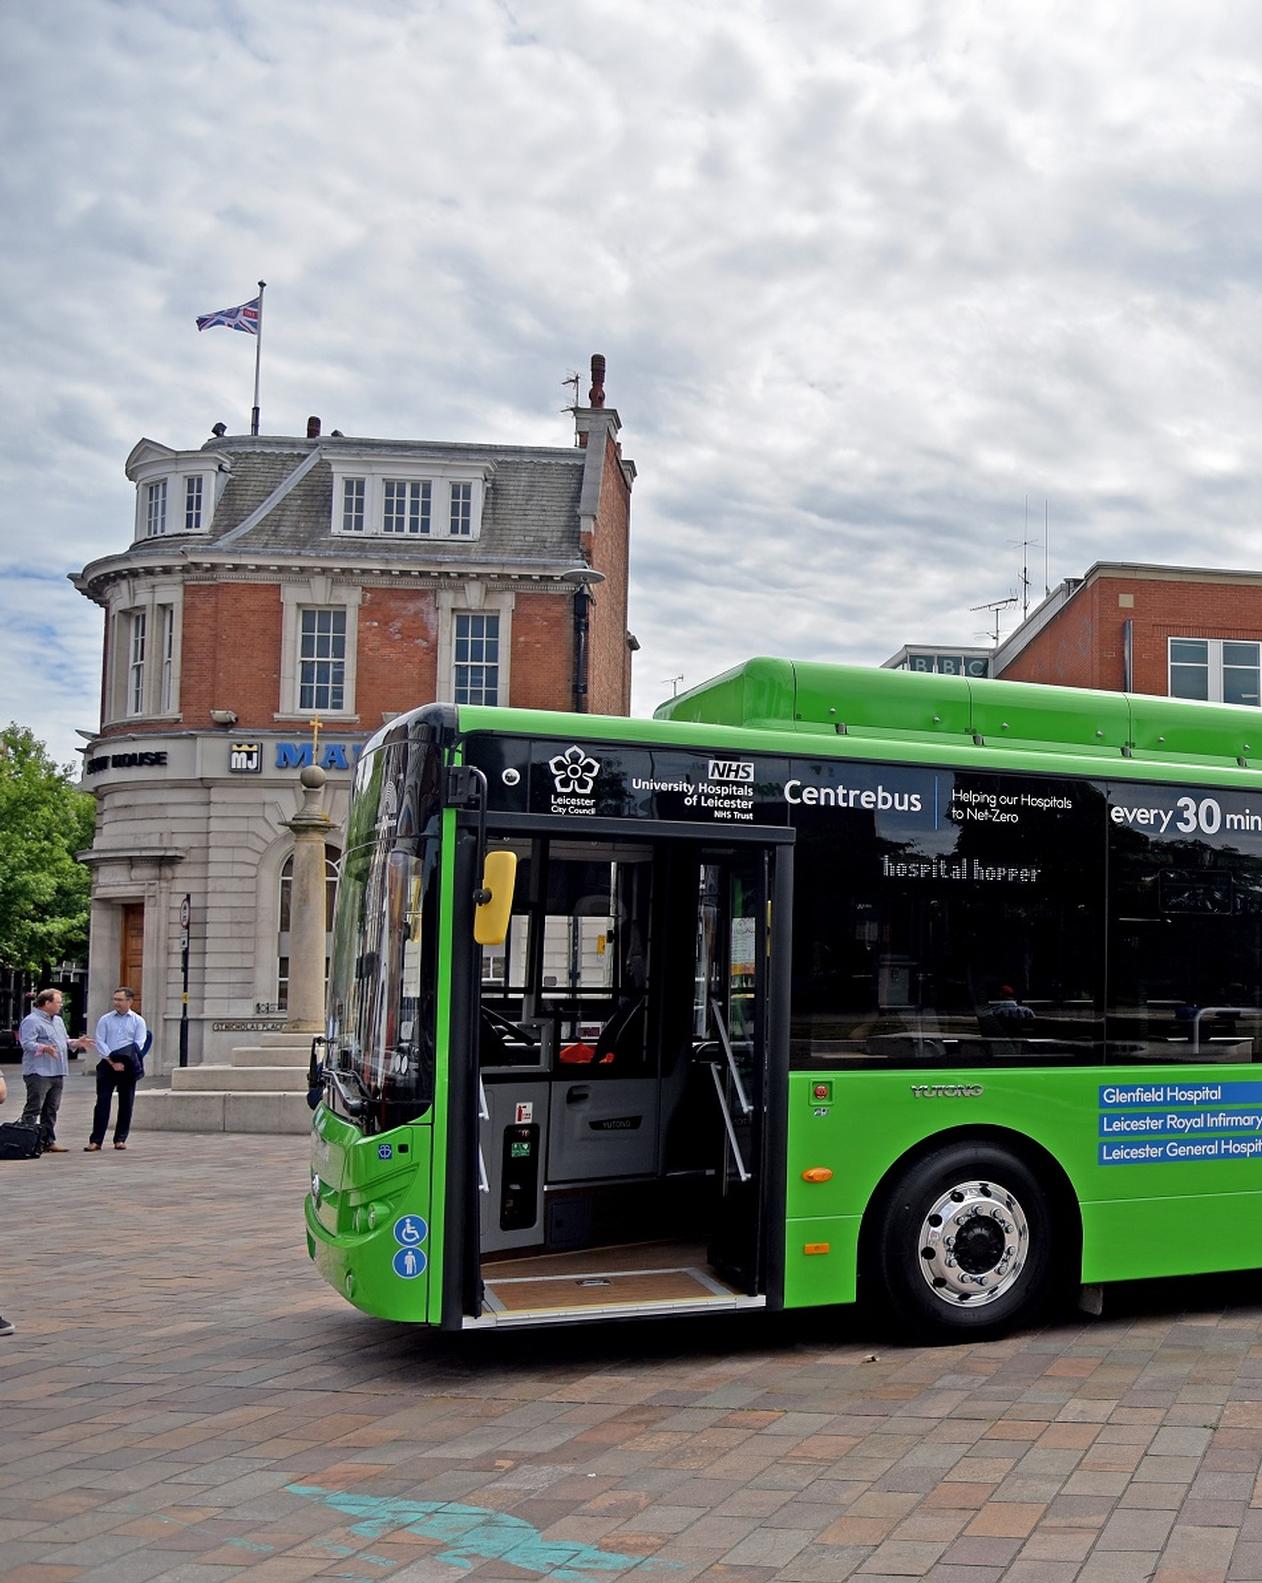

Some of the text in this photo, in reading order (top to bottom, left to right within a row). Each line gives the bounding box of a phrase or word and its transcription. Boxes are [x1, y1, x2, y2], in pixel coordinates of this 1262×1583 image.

[915, 658, 984, 676] BBC
[111, 751, 168, 768] HOUSE
[710, 761, 752, 779] NHS
[632, 778, 753, 798] University Hospitals
[783, 779, 922, 812] Centrebus
[551, 795, 596, 806] Leicester
[684, 795, 753, 809] of Leicester
[952, 789, 1072, 810] Helping our Hospitals
[551, 805, 596, 815] City Council
[714, 810, 753, 820] NHS Trust
[952, 808, 1019, 823] to Net-Zero
[1110, 803, 1174, 833] every
[1176, 797, 1221, 835] 30
[911, 1084, 984, 1098] YUTONG
[1103, 1085, 1221, 1105] Glenfield Hospital
[1103, 1116, 1164, 1132] Leicester
[1167, 1114, 1204, 1133] Royal
[1103, 1145, 1164, 1160] Leicester
[1166, 1140, 1218, 1157] General
